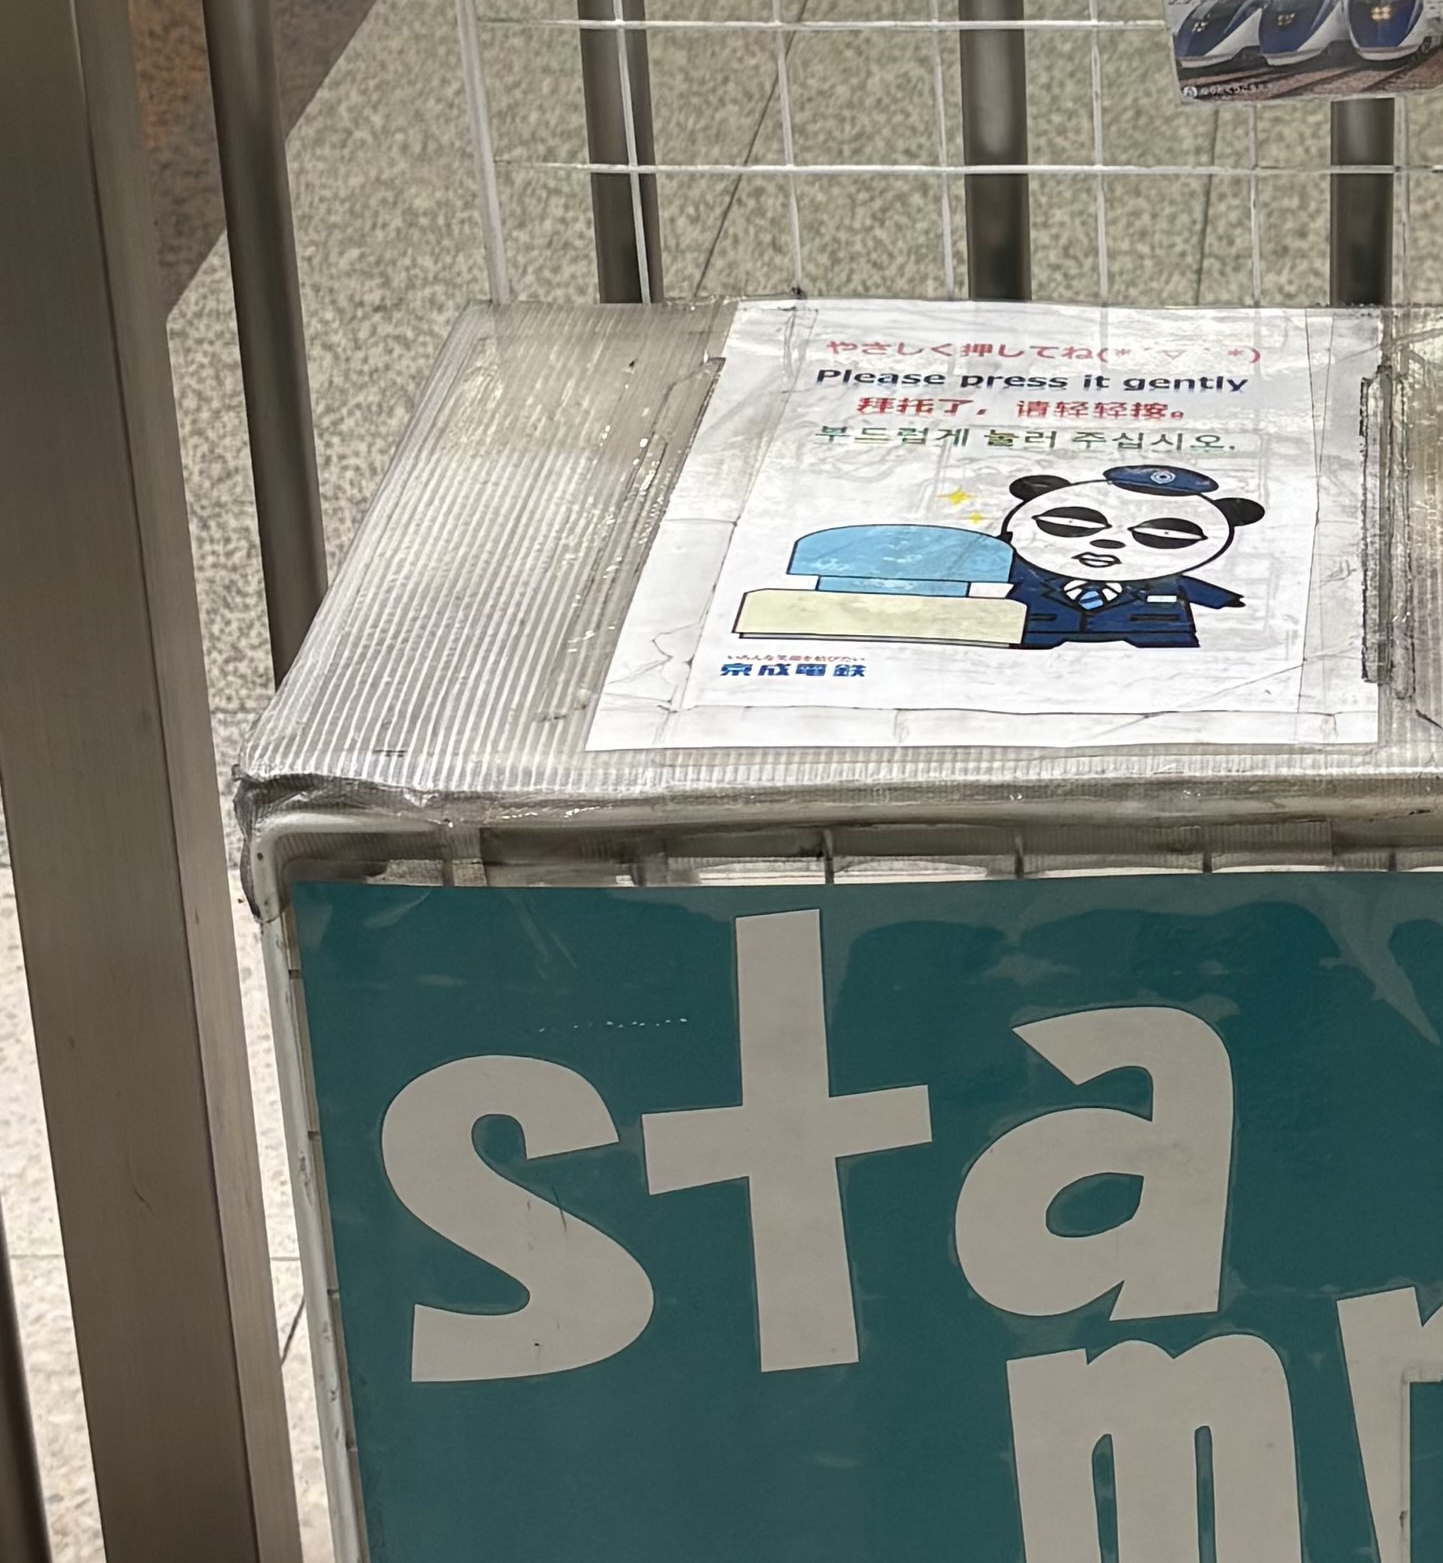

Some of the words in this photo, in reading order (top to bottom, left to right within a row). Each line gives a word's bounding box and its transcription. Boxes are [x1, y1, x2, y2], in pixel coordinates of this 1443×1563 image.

[817, 369, 946, 386] Please
[960, 374, 1068, 388] press
[1083, 374, 1110, 389] it
[1123, 375, 1248, 392] gently
[816, 425, 969, 447] 부드럽게
[984, 429, 1057, 449] 눌러
[1072, 431, 1235, 451] 주십시오.
